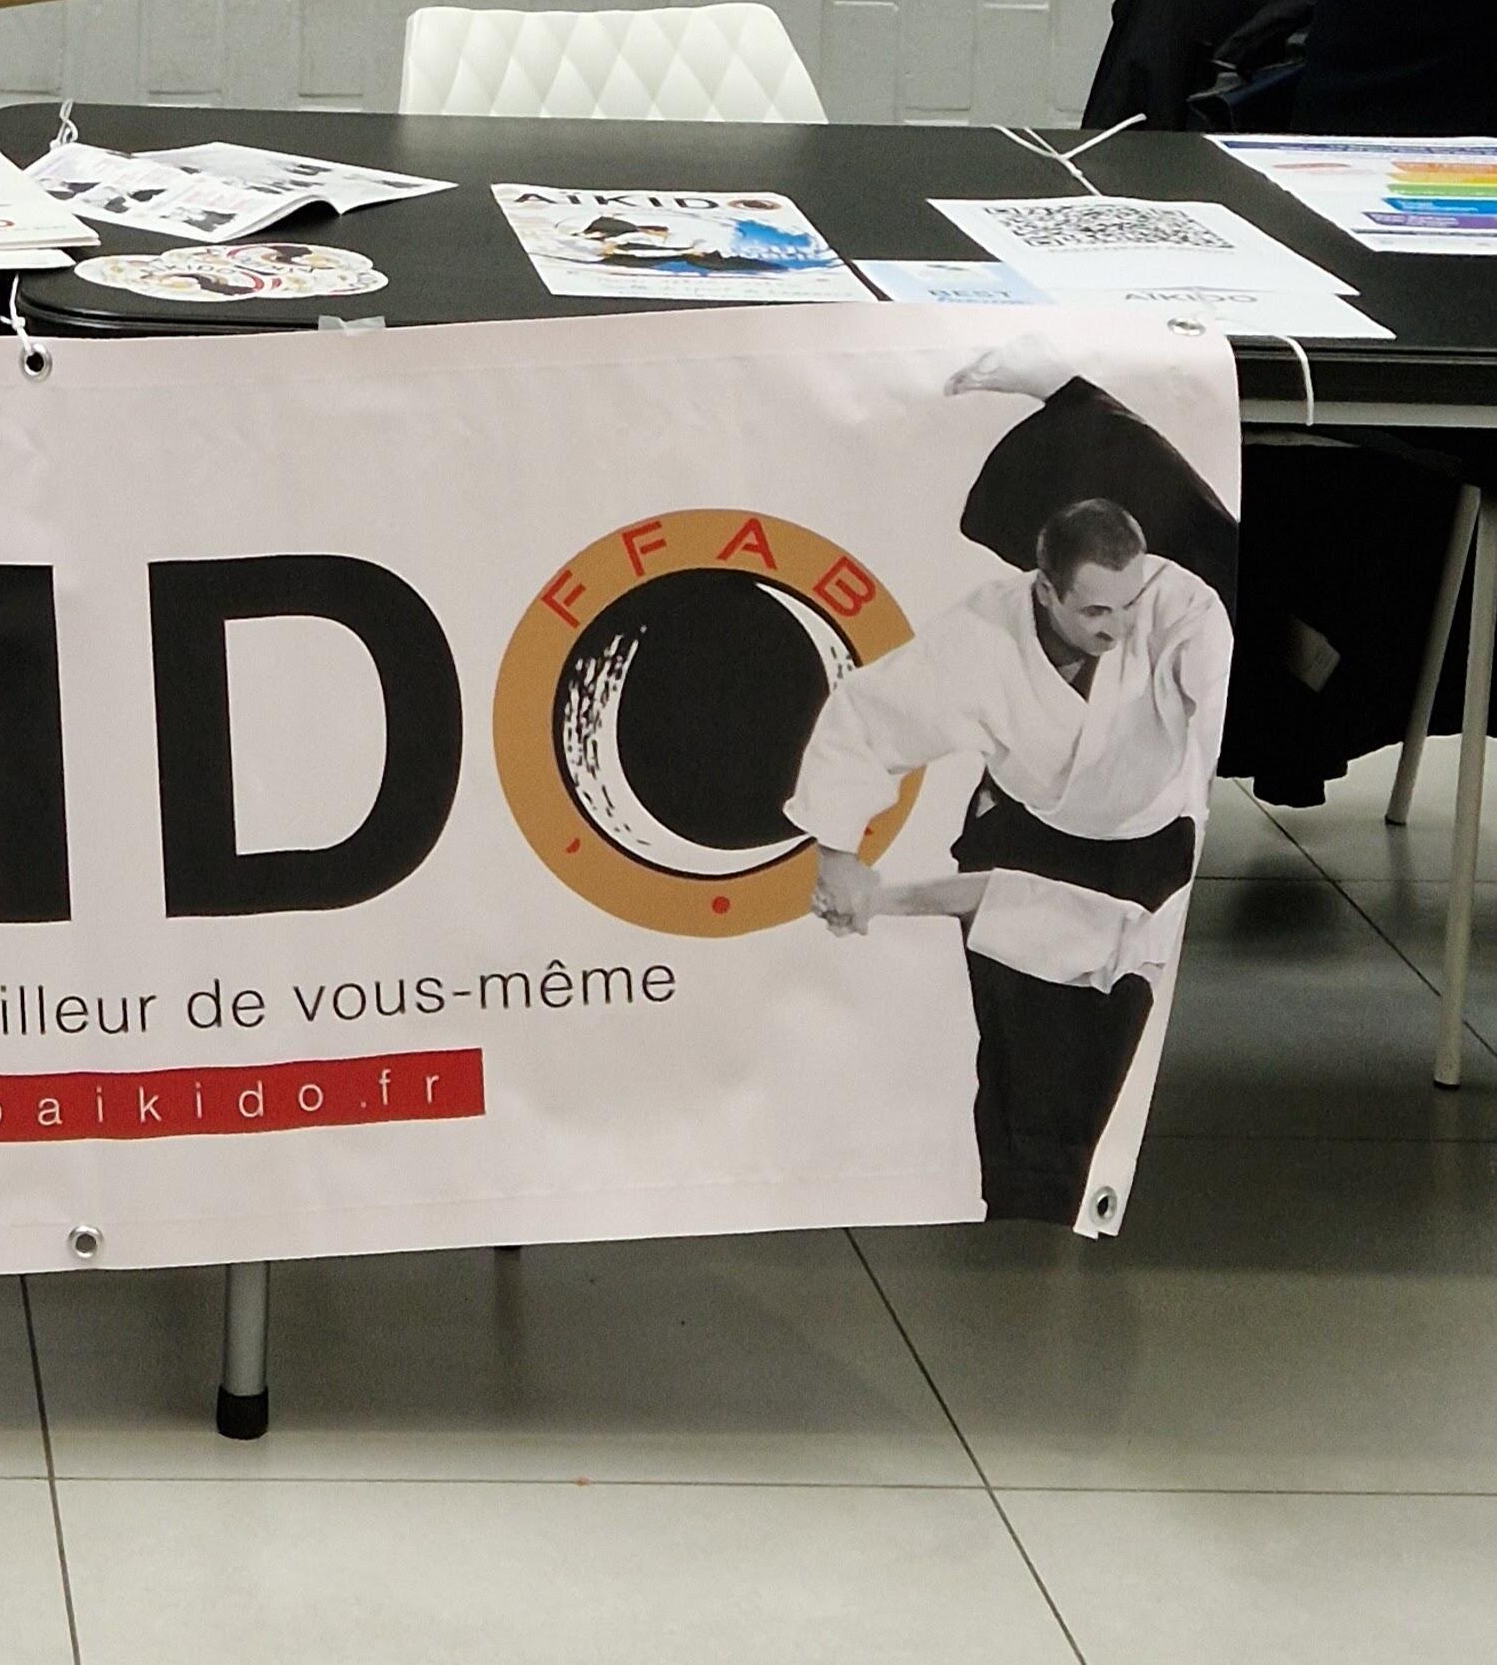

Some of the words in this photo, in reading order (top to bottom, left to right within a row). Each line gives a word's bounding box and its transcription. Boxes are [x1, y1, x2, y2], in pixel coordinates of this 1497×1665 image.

[540, 516, 877, 629] FFAB
[187, 977, 266, 1029] de
[292, 958, 677, 1024] vous-même
